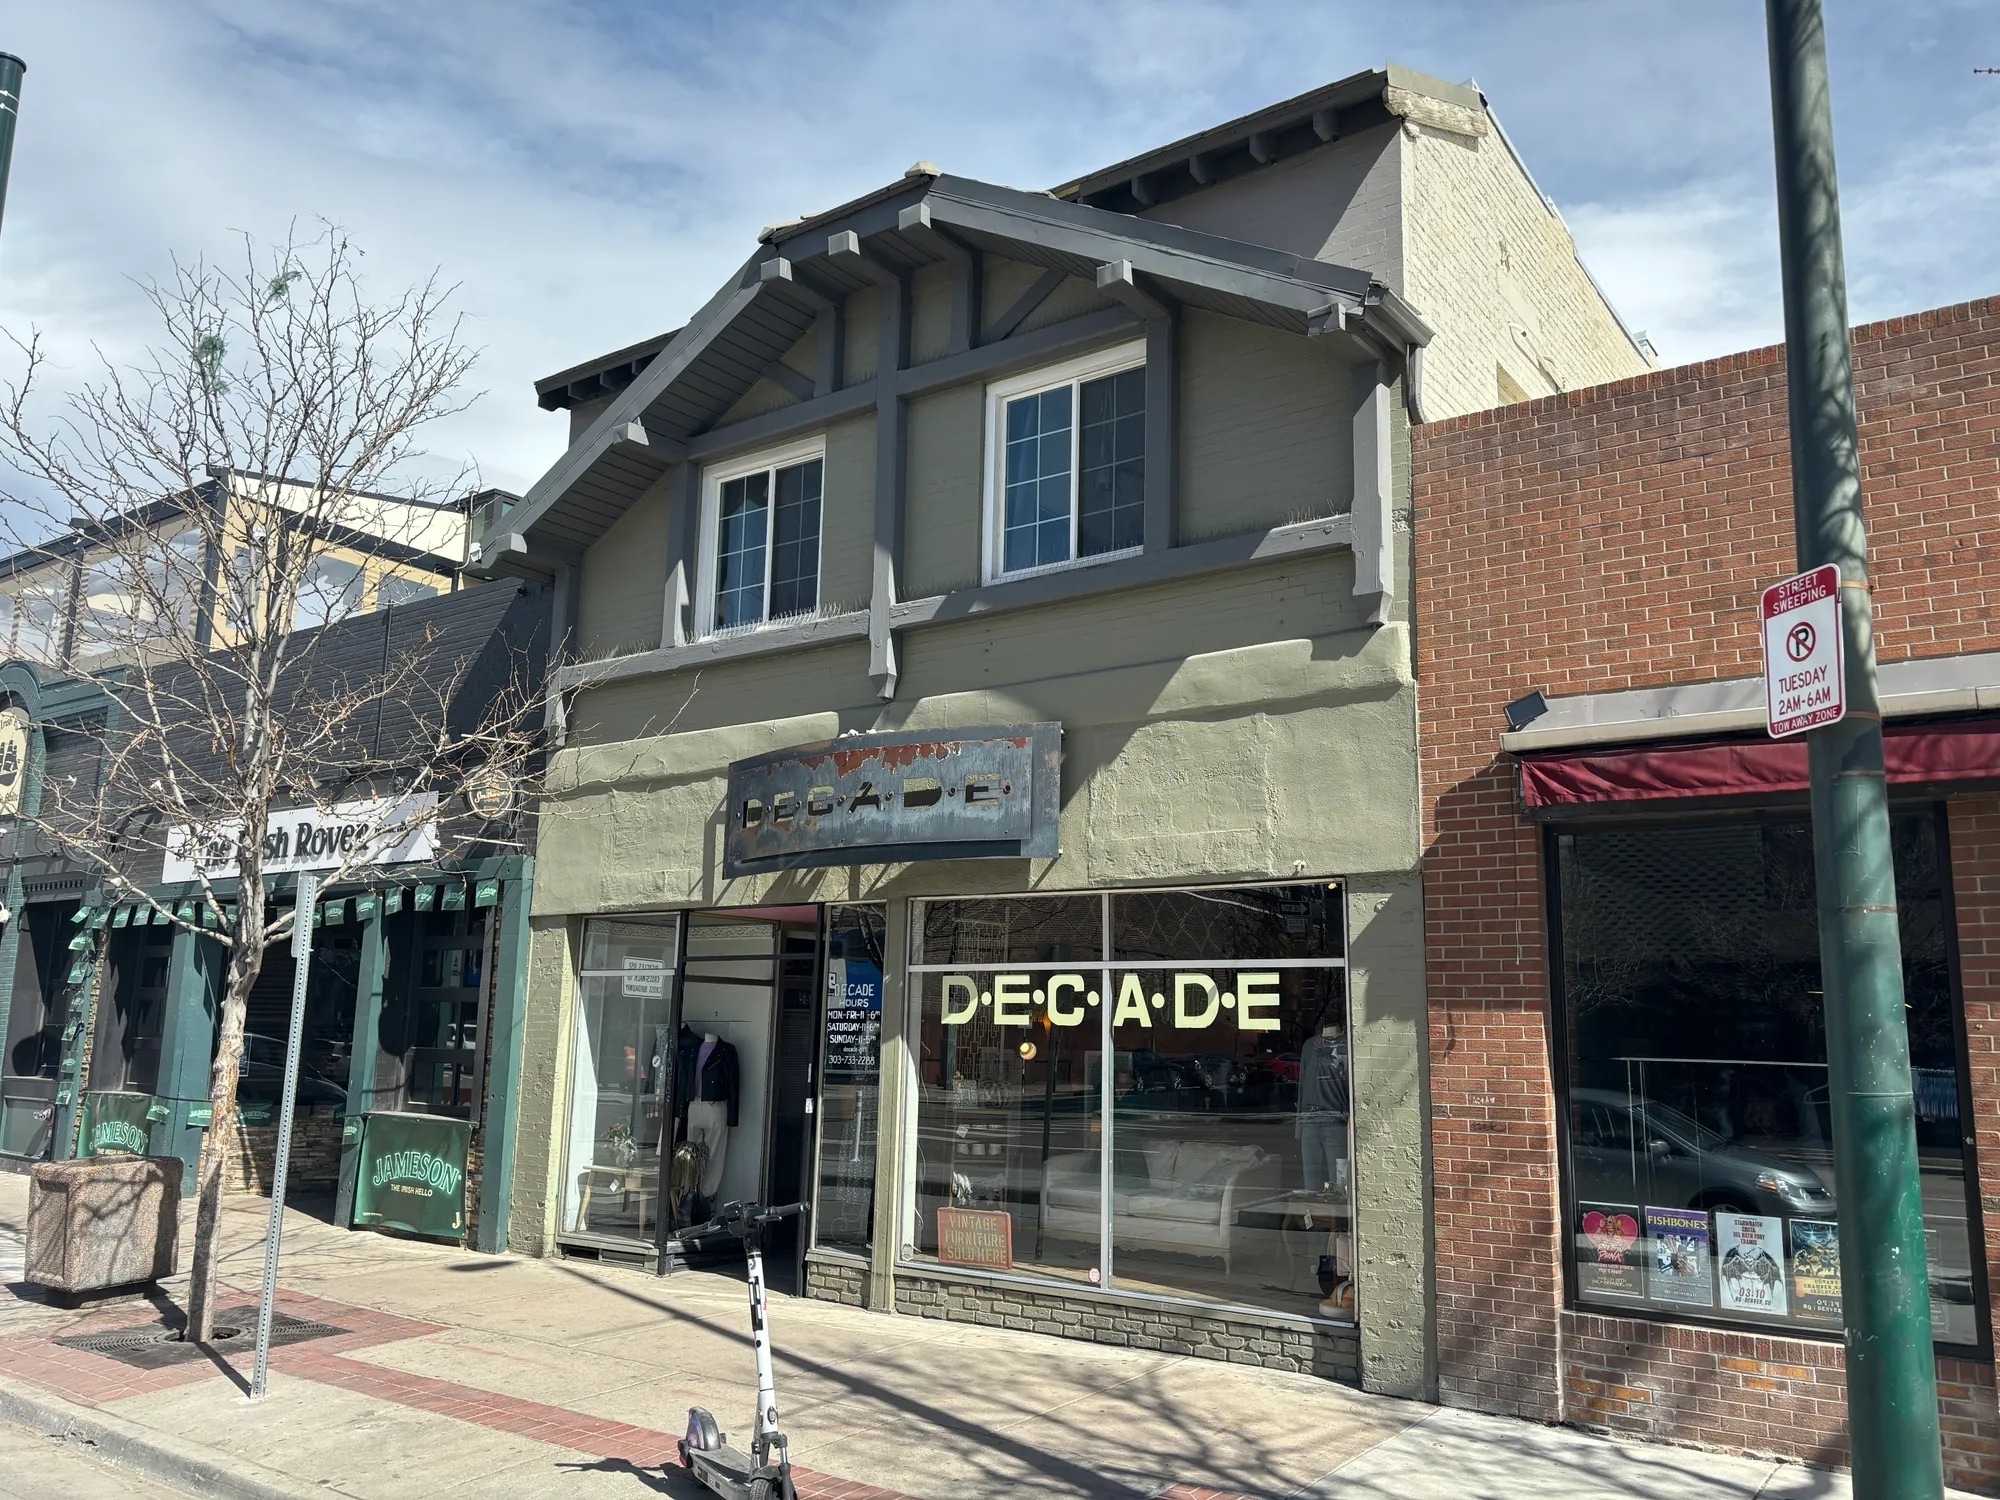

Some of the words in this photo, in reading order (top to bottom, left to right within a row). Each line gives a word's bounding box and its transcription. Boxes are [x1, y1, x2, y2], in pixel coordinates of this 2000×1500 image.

[1778, 573, 1818, 599] STREET
[1773, 584, 1827, 614] SWEEPING
[1778, 665, 1828, 694] TUESDAY
[1778, 686, 1831, 716] 2AM-6AM
[1773, 721, 1790, 734] TOW
[1791, 714, 1813, 730] AWAY
[1815, 707, 1838, 723] ZONE
[294, 821, 369, 856] Rover
[834, 984, 874, 996] DECADE
[839, 998, 869, 1008] HOURS
[828, 1054, 876, 1066] 303-733-2288
[372, 1151, 460, 1194] JAMESON
[390, 1184, 400, 1192] THE
[401, 1186, 414, 1195] IRISH
[414, 1188, 432, 1197] HELLO
[950, 1214, 996, 1231] VINTAGE
[946, 1229, 1006, 1248] FURNITURE
[948, 1246, 974, 1261] SOLD
[978, 1248, 1006, 1264] HERE
[1740, 1287, 1765, 1299] 03.10
